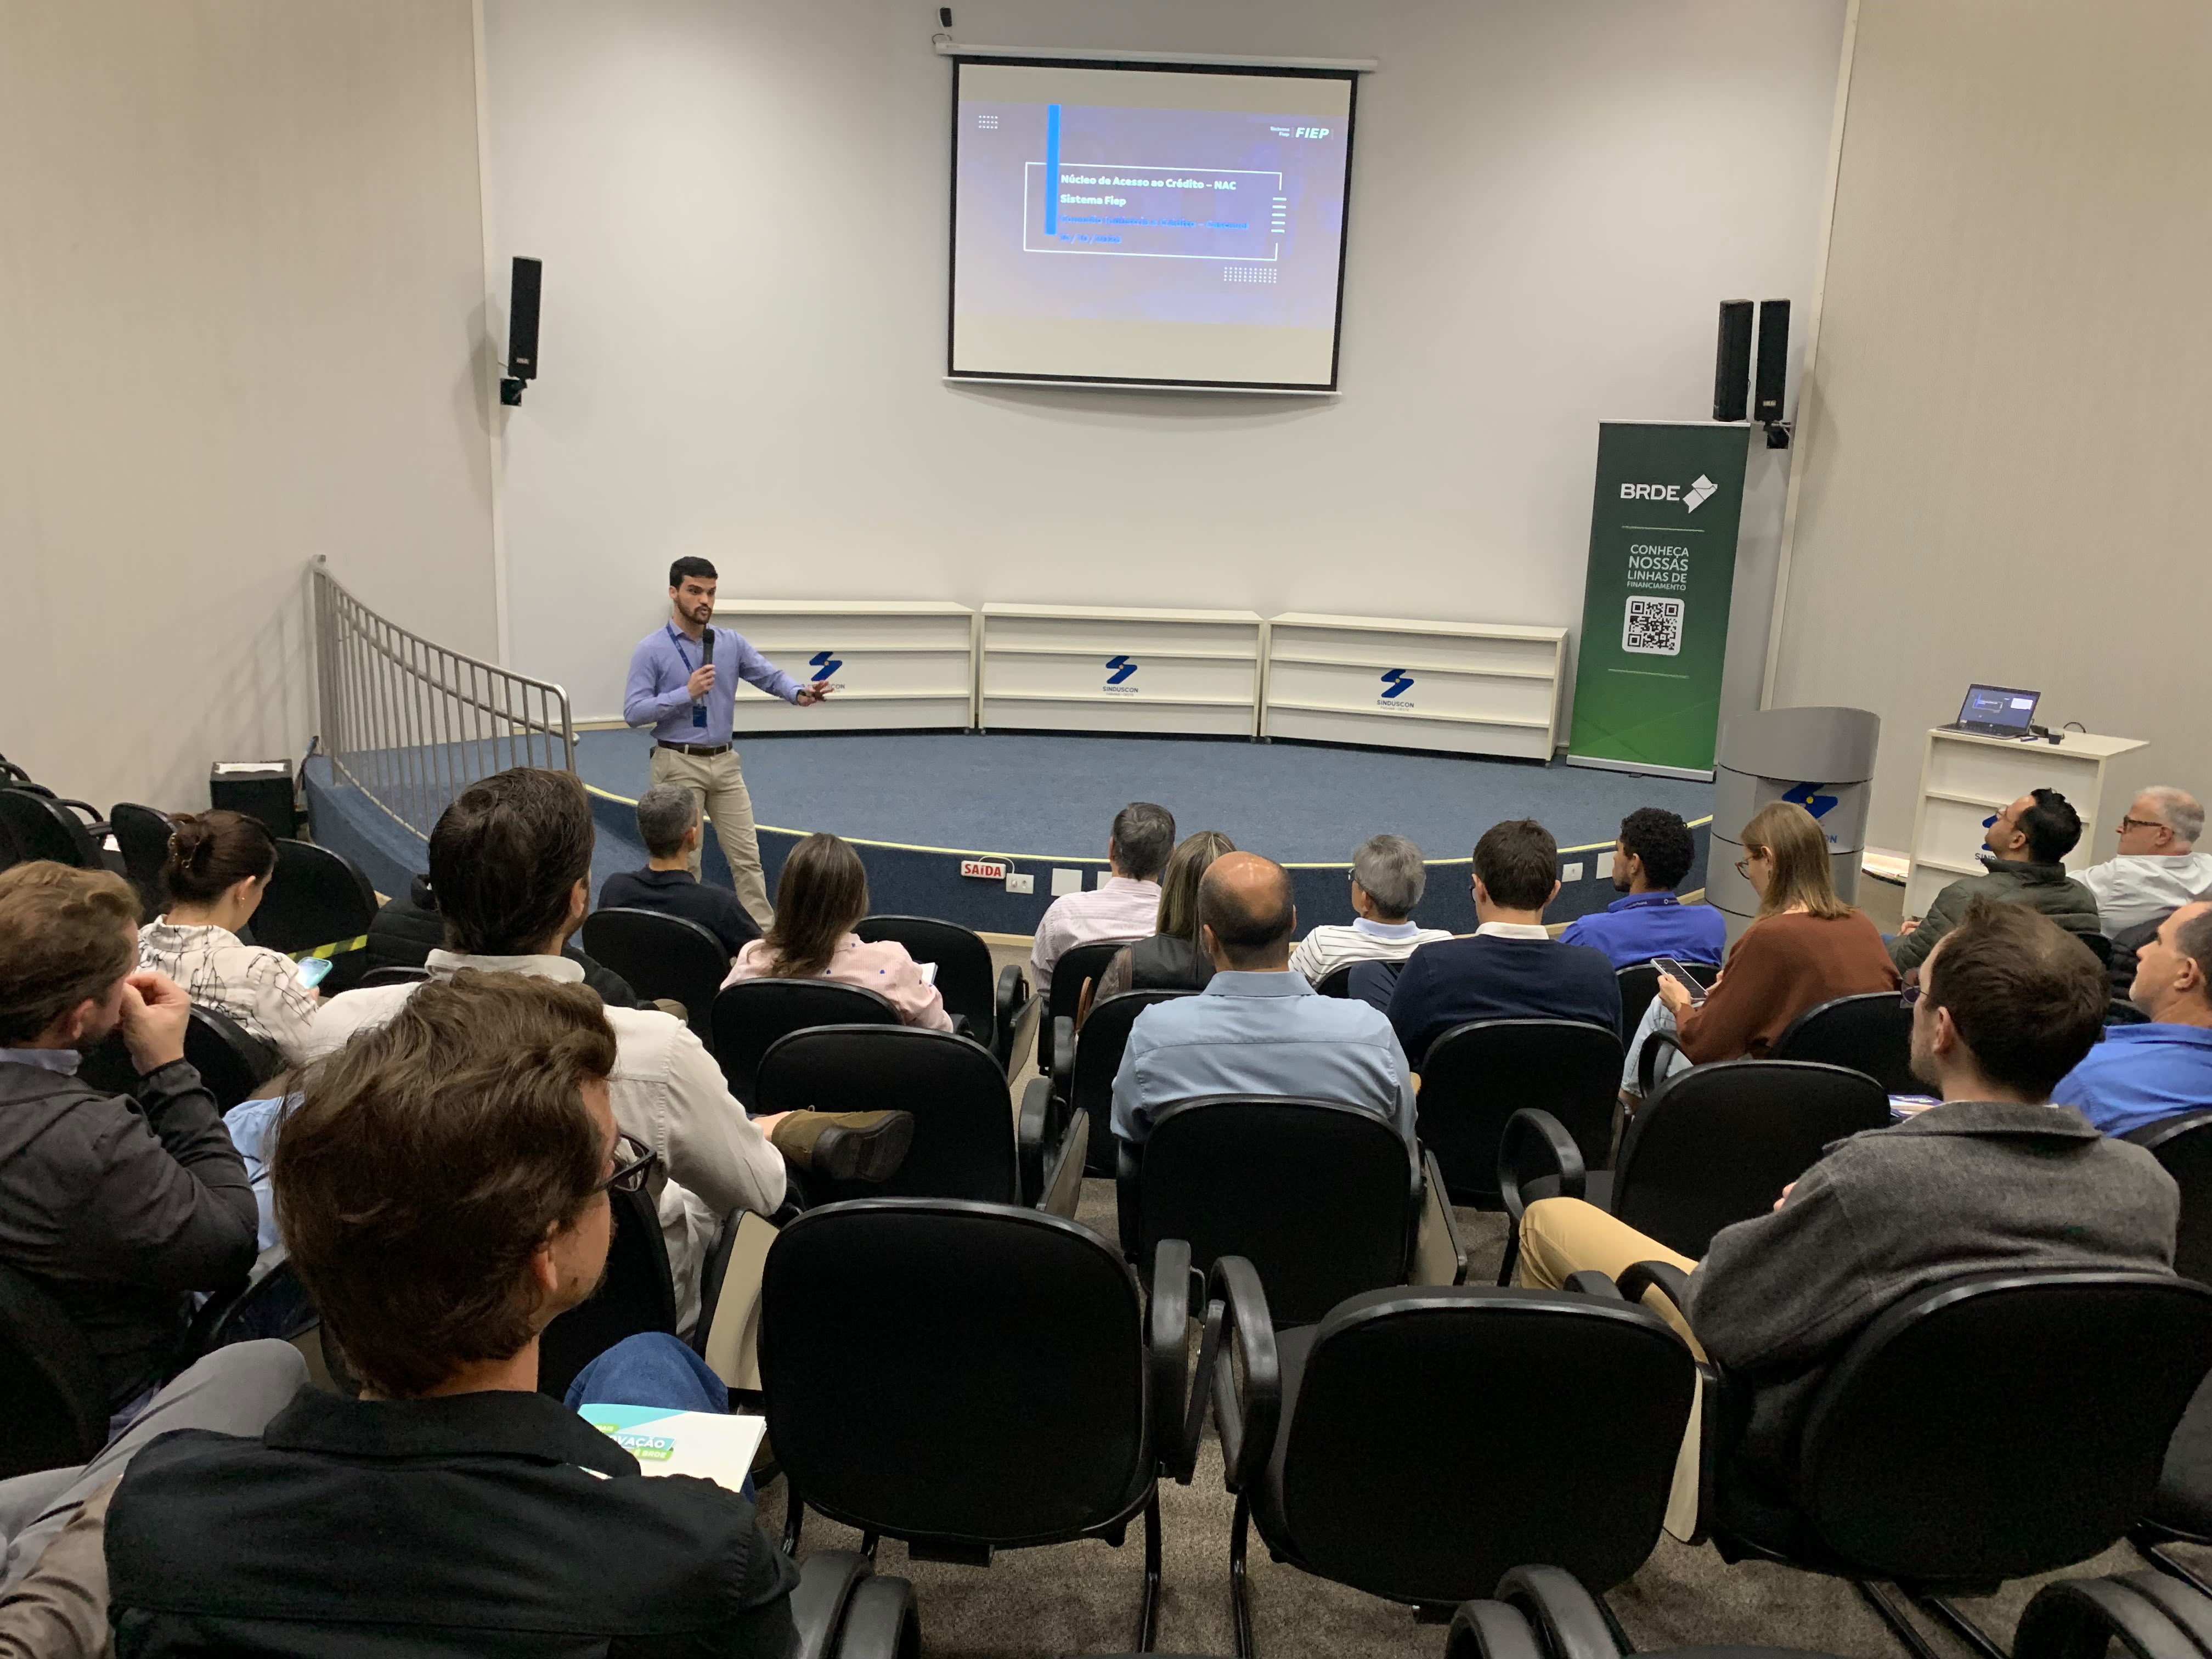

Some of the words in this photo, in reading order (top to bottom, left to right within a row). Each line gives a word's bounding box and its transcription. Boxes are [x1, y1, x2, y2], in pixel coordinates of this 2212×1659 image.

[1295, 127, 1329, 139] FIEP
[1061, 174, 1097, 184] Núcleo
[1098, 176, 1111, 185] de
[1113, 176, 1149, 187] Acesso
[1166, 178, 1204, 189] Crédito
[1214, 180, 1237, 190] NAC
[1060, 194, 1103, 205] Sistema
[1104, 195, 1126, 207] Fiep
[1620, 483, 1680, 501] BRDE
[1630, 544, 1689, 558] CONHEÇA
[1628, 556, 1689, 571] NOSSAS
[1627, 569, 1669, 582] LINHAS
[1672, 573, 1688, 583] DE
[1627, 581, 1686, 591] FINANCIAMENTO
[1377, 699, 1414, 708] SINDUSCON
[641, 1450, 668, 1458] BRDE
